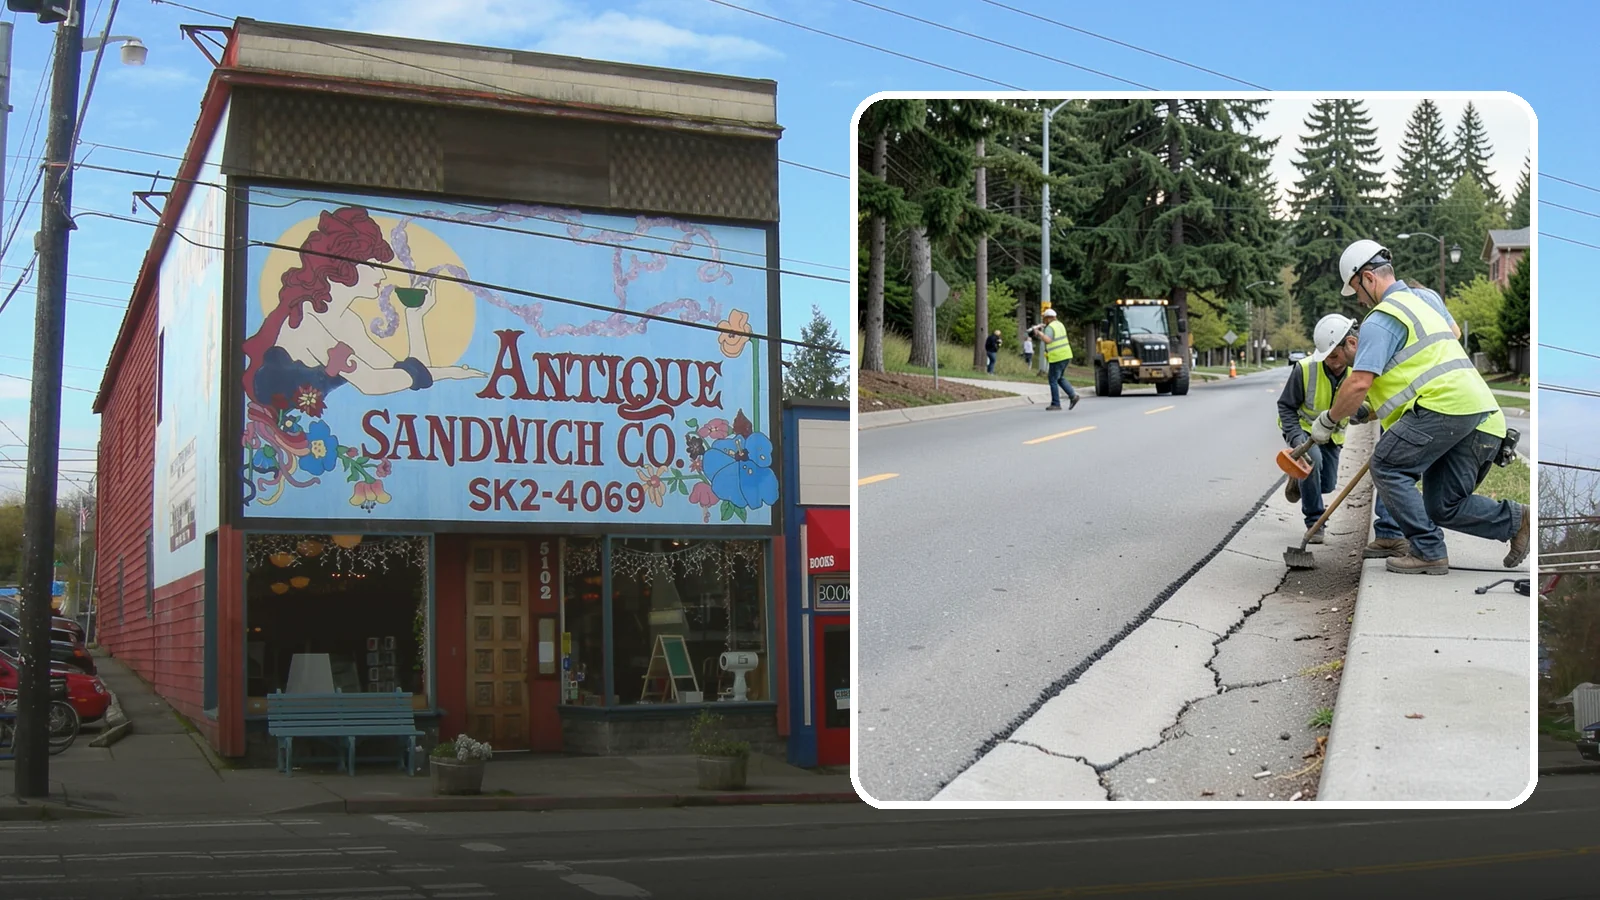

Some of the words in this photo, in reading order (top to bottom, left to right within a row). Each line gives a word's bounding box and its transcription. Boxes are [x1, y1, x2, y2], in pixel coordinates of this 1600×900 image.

[476, 329, 723, 420] ANTIQUE
[362, 409, 604, 467] SANDWICH
[617, 420, 685, 469] CO.
[468, 477, 646, 514] SK2-4069
[540, 542, 551, 599] 5102
[809, 555, 834, 569] BOOKS
